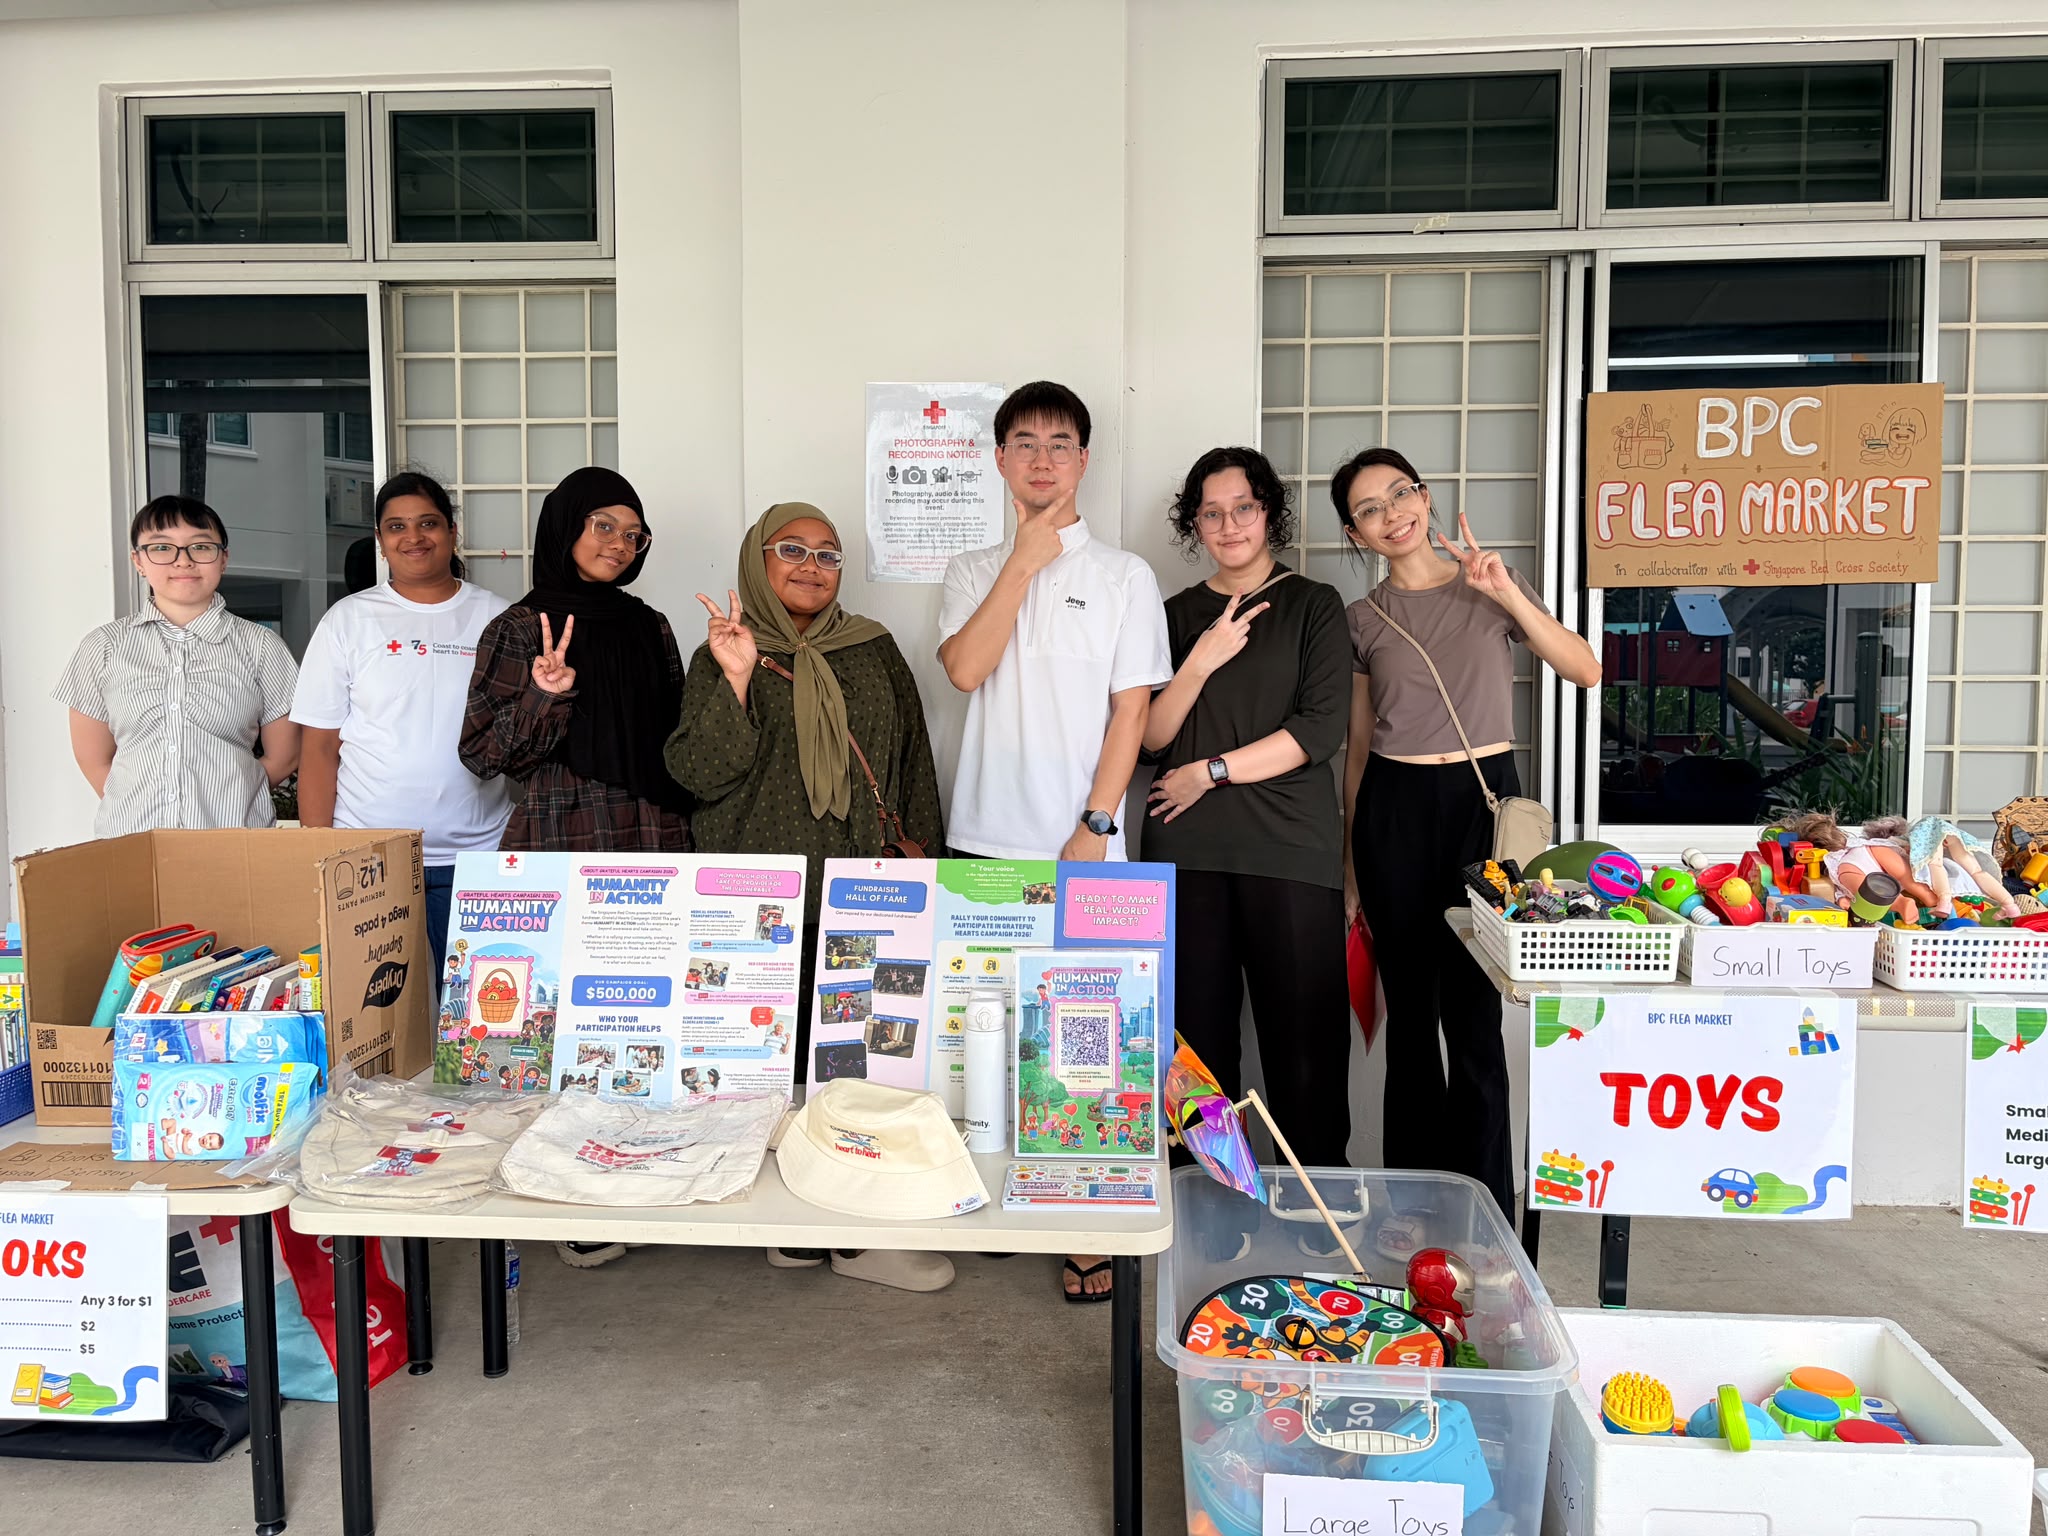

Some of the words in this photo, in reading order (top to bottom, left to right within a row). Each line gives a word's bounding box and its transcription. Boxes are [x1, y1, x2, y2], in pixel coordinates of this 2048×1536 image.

[1697, 396, 1822, 458] BPC
[894, 439, 966, 447] PHOTOGRAPHY
[968, 438, 975, 447] &
[888, 450, 944, 459] RECORDING
[946, 450, 981, 459] NOTICE
[1596, 479, 1726, 541] FLEA
[1739, 476, 1931, 536] MARKET
[1615, 564, 1627, 576] in
[1637, 561, 1708, 576] collaboration
[1717, 563, 1738, 577] with
[1763, 562, 1806, 578] Singapore
[1811, 562, 1829, 575] Red
[1836, 562, 1864, 574] Cross
[1868, 561, 1909, 577] Society
[1065, 596, 1086, 607] Jeep
[411, 640, 427, 656] 75
[360, 860, 385, 889] L42
[978, 864, 995, 872] Your
[586, 878, 670, 891] HUMANITY
[854, 885, 899, 893] FUNDRAISER
[359, 888, 386, 906] PREMIUM
[590, 892, 604, 901] IN
[604, 892, 663, 904] ACTION
[845, 894, 866, 902] HALL
[869, 894, 881, 902] OF
[883, 895, 908, 904] FAME
[1075, 895, 1108, 903] READY
[1111, 895, 1125, 904] TO
[1128, 896, 1158, 904] MAKE
[337, 898, 358, 912] PANTS
[459, 900, 555, 915] HUMANITY
[1083, 906, 1108, 914] REAL
[1112, 906, 1149, 915] WORLD
[388, 904, 410, 923] Mega
[354, 913, 379, 938] packs
[380, 914, 387, 930] 4
[463, 916, 478, 926] IN
[480, 916, 546, 930] ACTION
[1093, 917, 1139, 926] IMPACT?
[1712, 946, 1781, 978] Small
[1798, 948, 1851, 984] Toys
[367, 968, 403, 1000] Drypers
[1053, 973, 1119, 983] HUMANITY
[586, 987, 657, 1001] $500,000
[1056, 984, 1067, 992] IN
[1069, 985, 1114, 994] ACTION
[599, 1015, 616, 1023] WHO
[1648, 1013, 1666, 1024] BPC
[1670, 1013, 1691, 1025] FLEA
[1695, 1014, 1733, 1026] MARKET
[575, 1024, 635, 1032] PARTICIPATION
[636, 1025, 662, 1033] HELPS
[44, 1062, 112, 1073] 101132000
[227, 1078, 238, 1103] Extra
[254, 1076, 269, 1124] molfix
[1600, 1072, 1784, 1132] TOYS
[225, 1104, 237, 1121] Dry
[48, 1151, 108, 1162] Books
[835, 1143, 854, 1155] heart
[862, 1147, 881, 1159] heart
[63, 1167, 142, 1181] Sensory
[21, 1213, 54, 1225] MARKET
[80, 1295, 105, 1309] Any
[108, 1296, 115, 1306] 3
[117, 1296, 136, 1307] for
[138, 1296, 152, 1307] $1
[1240, 1284, 1269, 1310] 30
[1332, 1297, 1350, 1309] 70
[80, 1321, 96, 1332] $2
[1381, 1312, 1405, 1328] 60
[1188, 1324, 1213, 1347] 20
[80, 1343, 95, 1354] $5
[1213, 1389, 1238, 1413] 60
[1346, 1402, 1376, 1428] 30
[1284, 1497, 1370, 1536] Large
[1388, 1498, 1449, 1536] Toys
